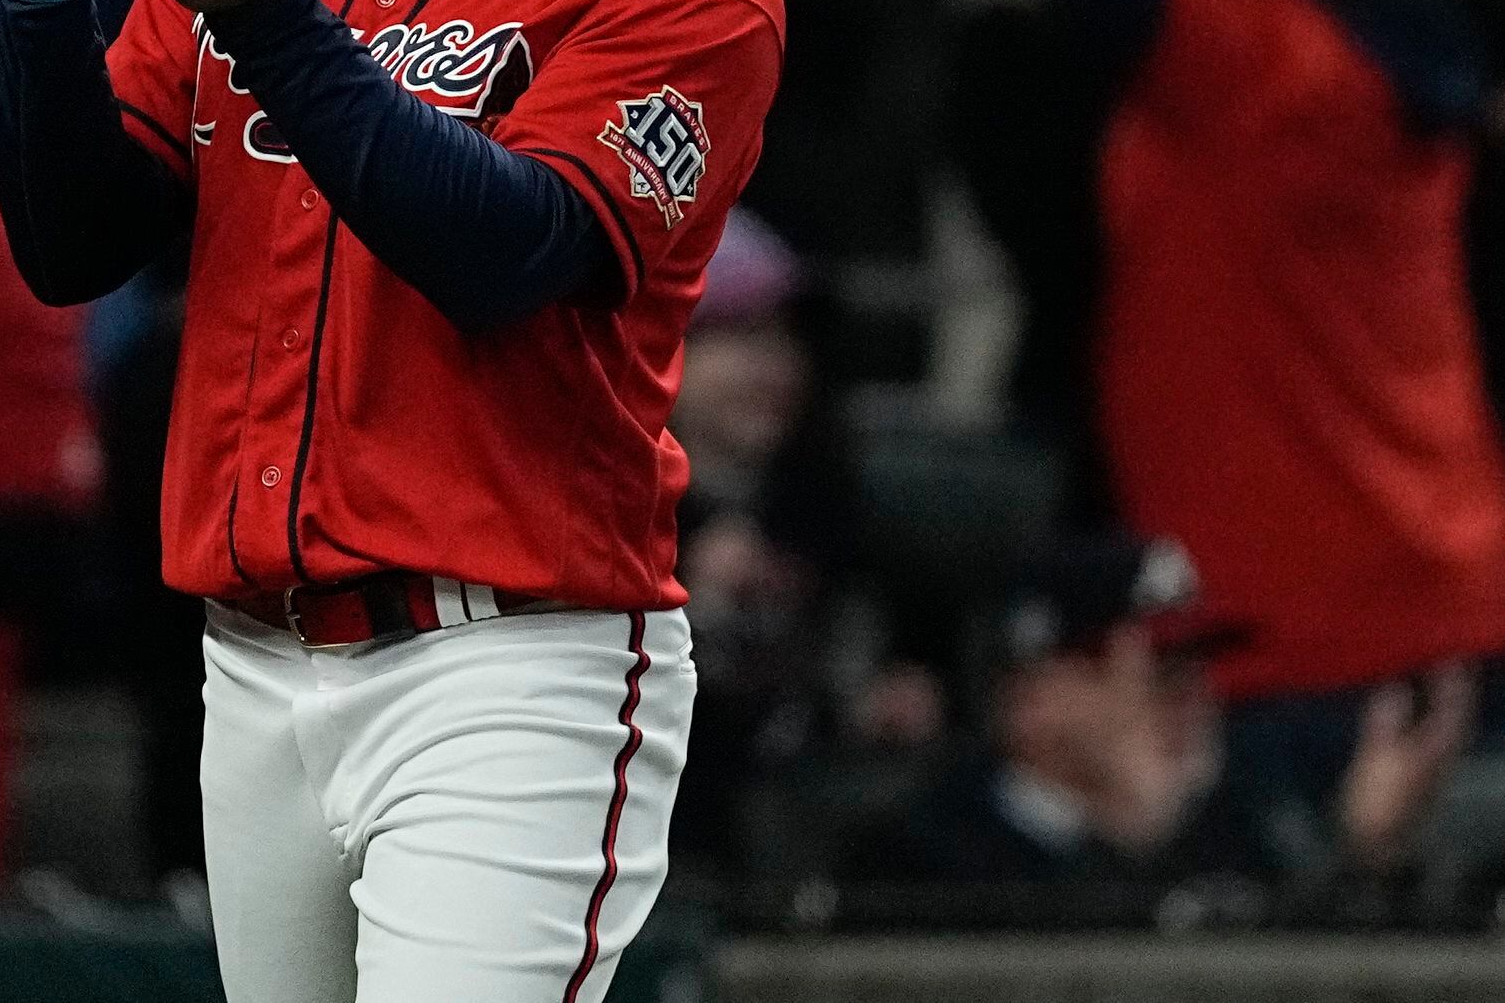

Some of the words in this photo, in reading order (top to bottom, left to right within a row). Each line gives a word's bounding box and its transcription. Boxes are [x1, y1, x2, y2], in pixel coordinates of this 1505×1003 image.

[625, 97, 702, 196] 150
[668, 95, 705, 147] BRAVES
[625, 148, 668, 200] ANNIVERSARY
